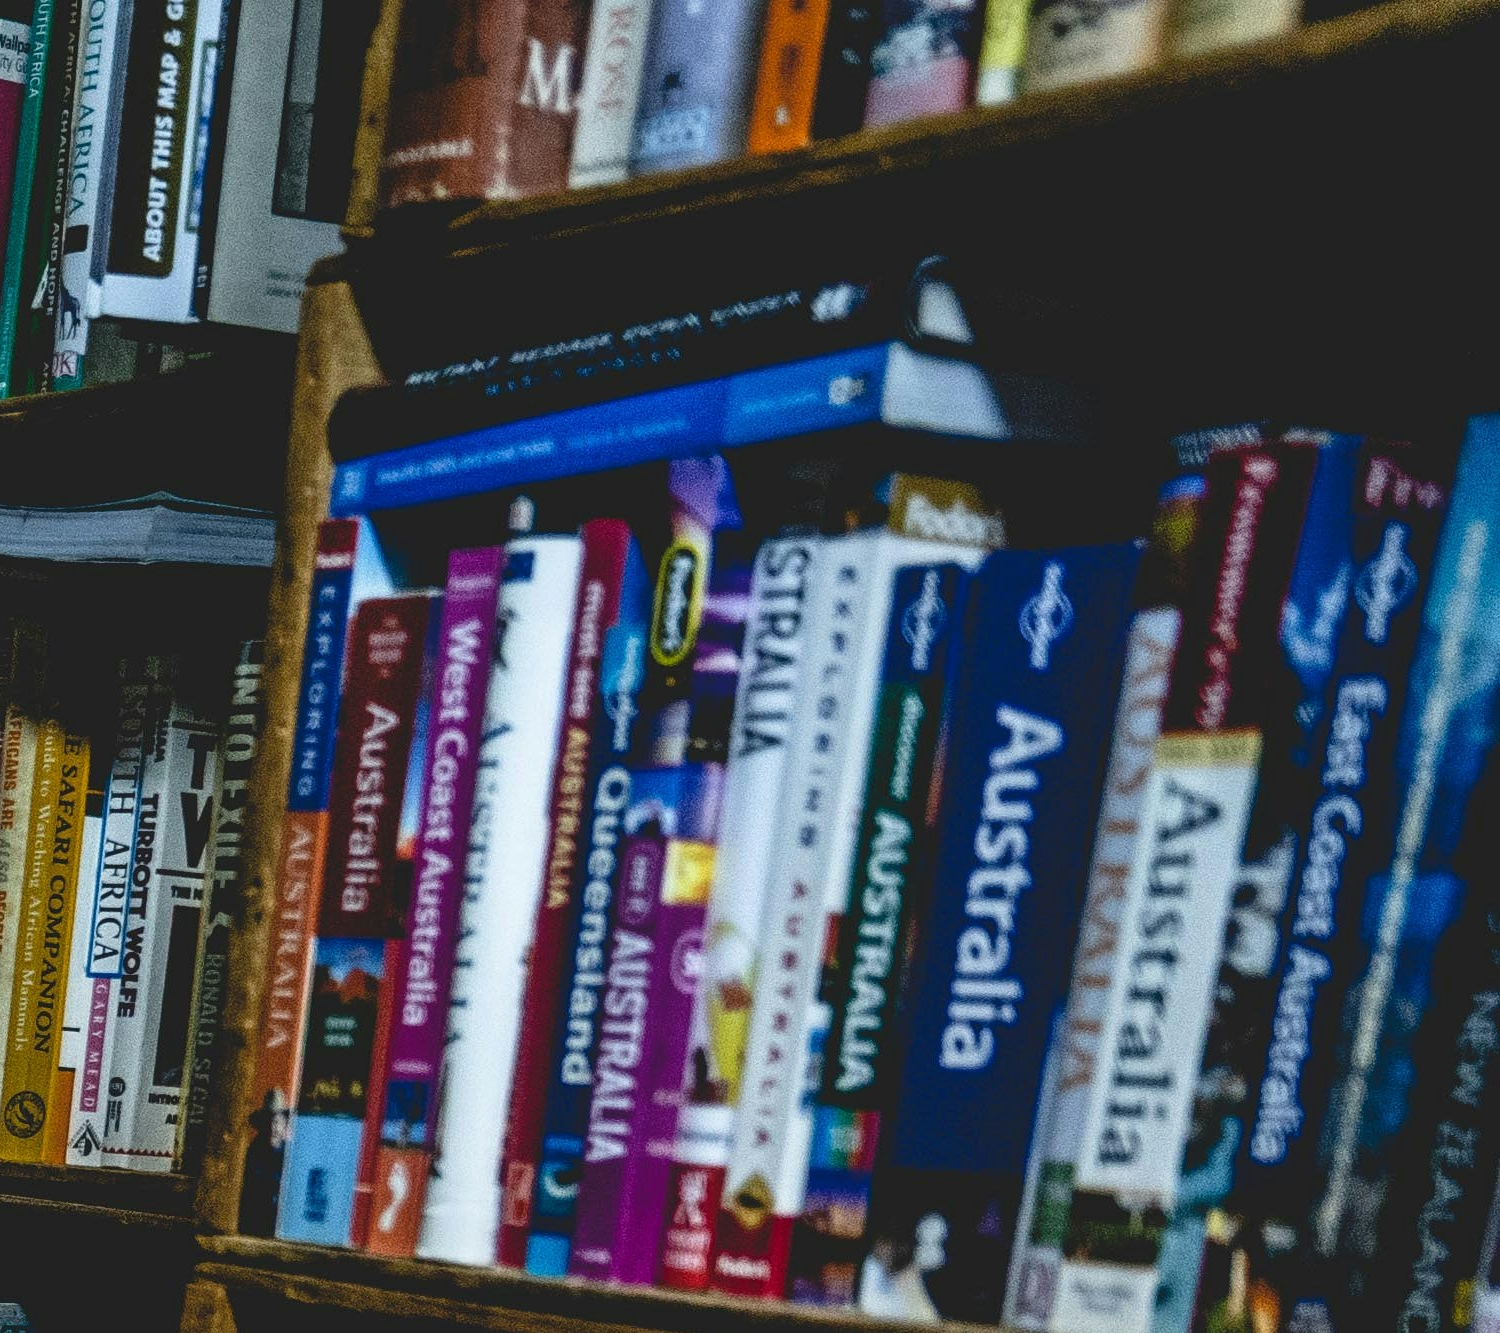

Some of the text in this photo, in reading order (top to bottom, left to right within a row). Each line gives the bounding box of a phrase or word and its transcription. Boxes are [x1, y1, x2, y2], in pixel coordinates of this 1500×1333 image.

[68, 104, 95, 215] AFRICA
[143, 53, 181, 262] ABOUT THIS MAP
[90, 839, 127, 963] AFRICA
[116, 796, 157, 1019] TURBOTT WOLFE
[341, 702, 400, 914] Australia
[402, 617, 486, 1027] West Coast Australia
[939, 703, 1065, 1075] Australia
[560, 765, 631, 1088] Queensland
[837, 810, 913, 1094] AUSTRALIA
[1098, 779, 1221, 1168] Australia
[590, 927, 653, 1162] AUSTRALIA
